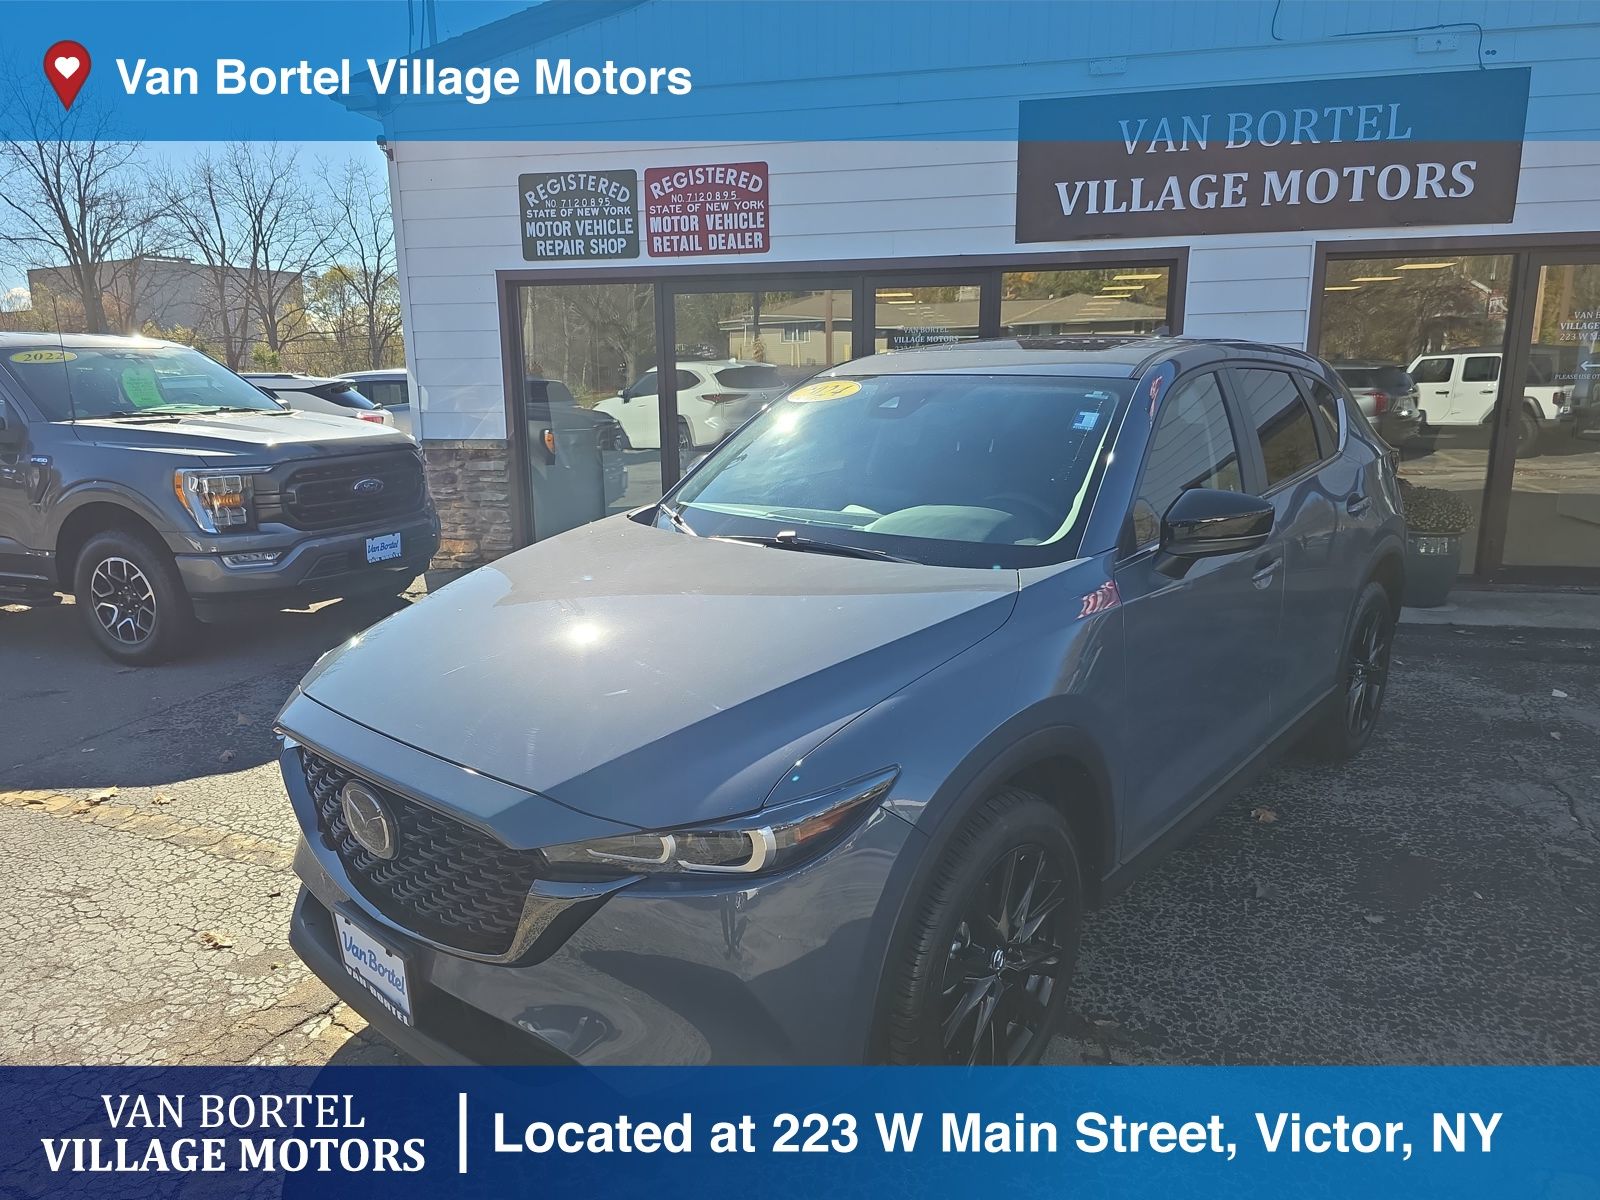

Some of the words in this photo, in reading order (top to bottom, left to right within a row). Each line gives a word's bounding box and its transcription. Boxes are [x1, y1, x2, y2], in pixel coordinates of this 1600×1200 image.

[1118, 114, 1211, 155] VAN
[1225, 103, 1412, 149] BORTEL
[524, 173, 630, 208] REGISTERED
[649, 166, 763, 200] REGISTERED
[1054, 172, 1249, 216] VILLAGE
[1260, 160, 1477, 206] MOTORS
[560, 197, 611, 207] 7120895
[686, 190, 737, 202] 7120895
[526, 209, 557, 218] STATE
[560, 208, 574, 217] OF
[577, 207, 600, 216] NEW
[603, 206, 632, 216] YORK
[649, 204, 683, 214] STATE
[686, 203, 702, 213] OF
[705, 202, 730, 212] NEW
[734, 200, 765, 211] YORK
[525, 220, 572, 238] MOTOR
[575, 218, 634, 236] VEHICLE
[649, 215, 700, 233] MOTOR
[705, 211, 765, 231] VEHICLE
[536, 240, 585, 256] REPAIR
[590, 238, 627, 255] SHOP
[653, 234, 703, 253] RETAIL
[708, 231, 763, 251] DEALER
[1574, 311, 1594, 319] VAN
[1560, 322, 1600, 330] VILLAGE
[926, 335, 959, 343] MOTORS
[1560, 333, 1576, 341] 223
[22, 352, 64, 362] 2022
[342, 931, 368, 965] Van
[367, 949, 405, 995] Bortel
